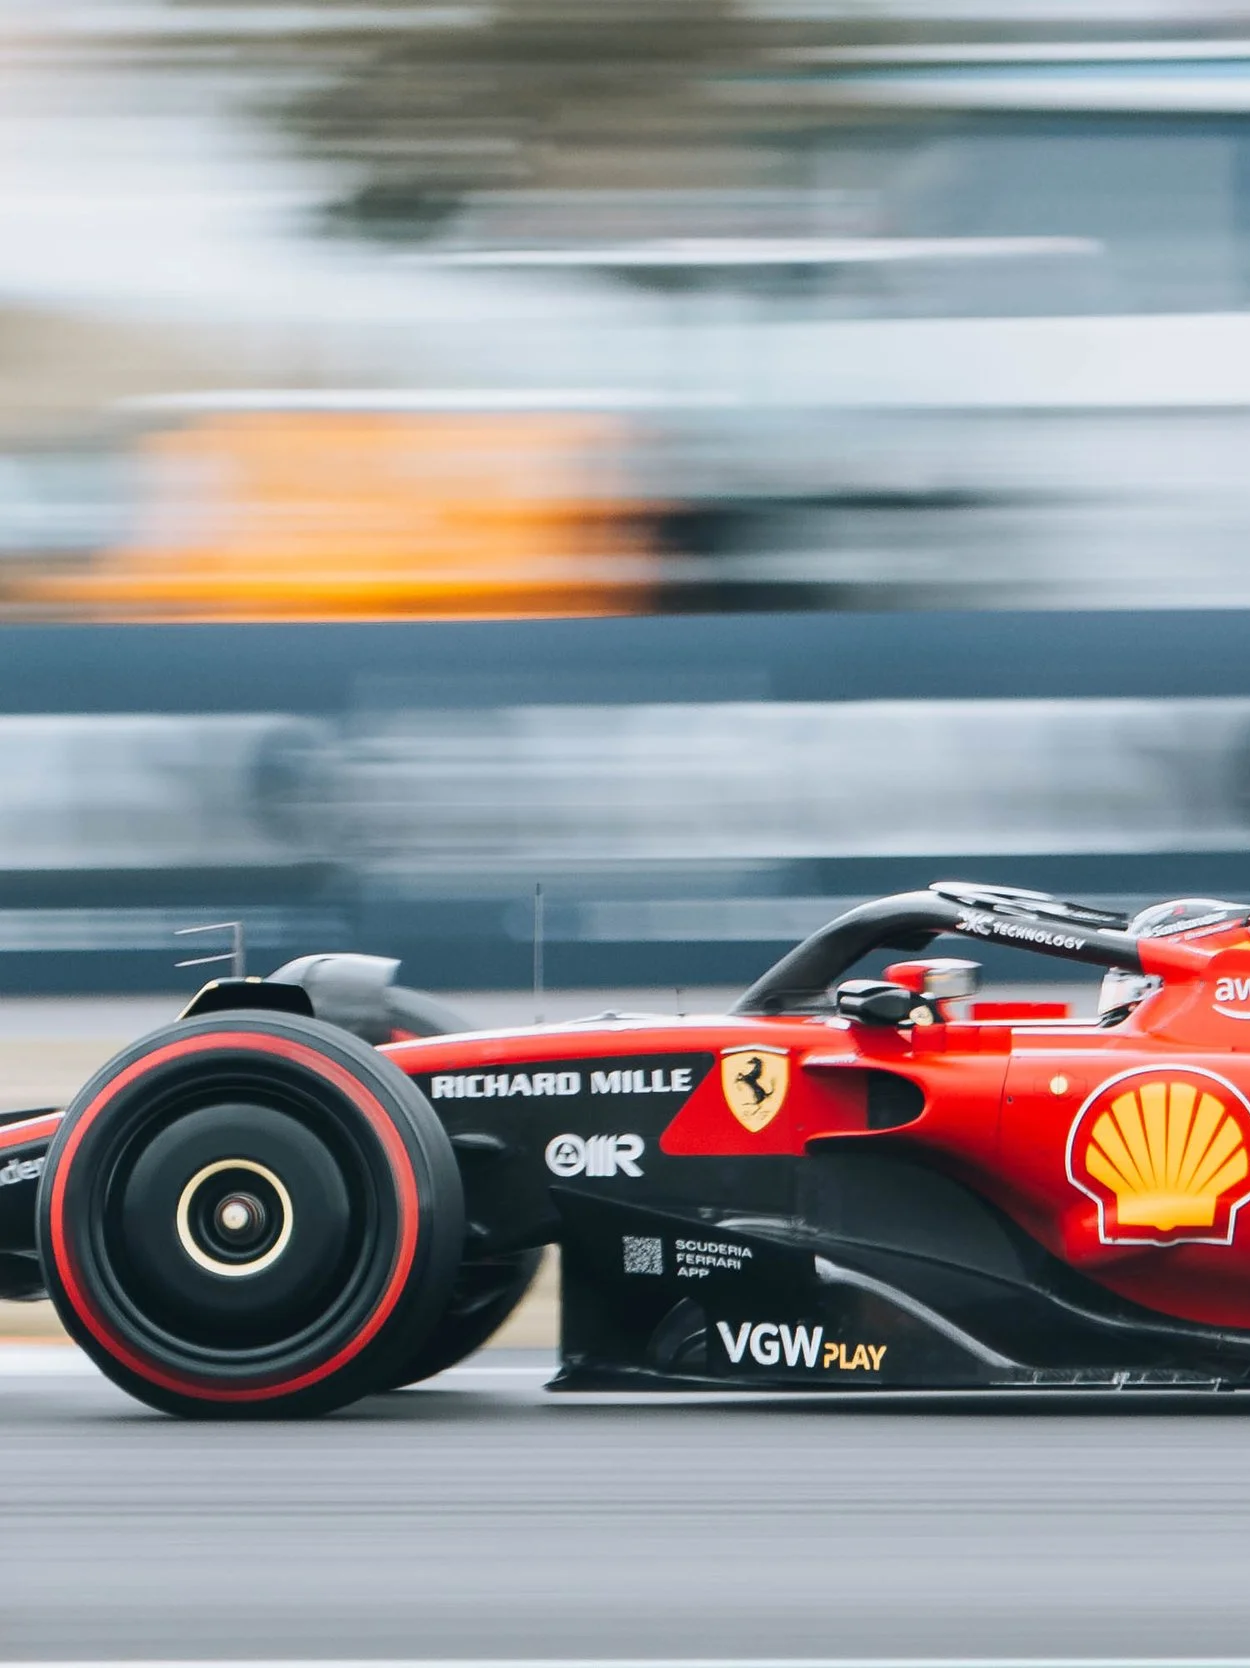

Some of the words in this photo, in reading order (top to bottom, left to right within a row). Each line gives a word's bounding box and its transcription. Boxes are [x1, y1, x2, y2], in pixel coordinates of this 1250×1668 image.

[993, 921, 1087, 950] TECHNOLOGY
[431, 1072, 581, 1099] RICHARD
[591, 1068, 693, 1094] MILLE
[0, 1156, 46, 1187] der
[675, 1239, 753, 1259] SCUDERIA
[676, 1253, 742, 1270] FERRARI
[677, 1267, 710, 1278] APP
[716, 1321, 823, 1368] VGW
[823, 1342, 887, 1371] PLAY
